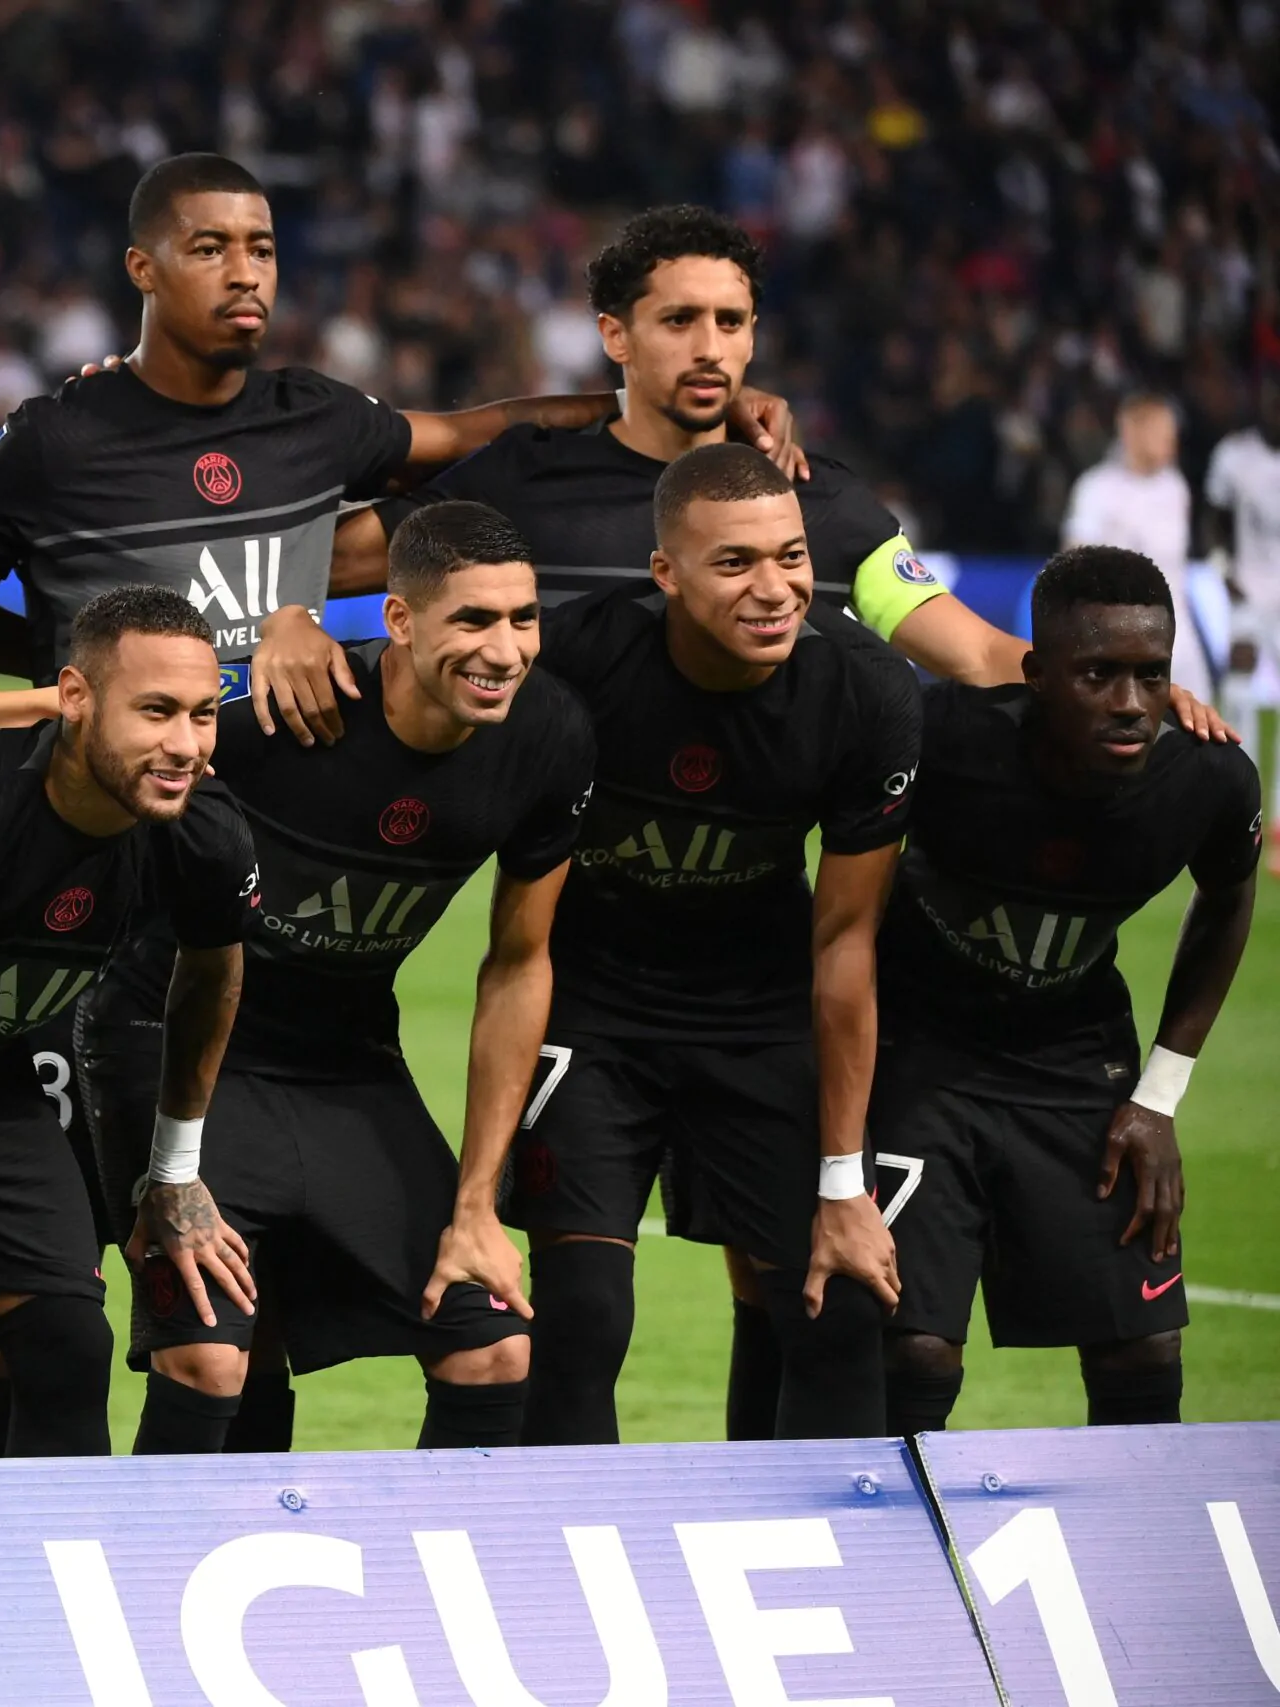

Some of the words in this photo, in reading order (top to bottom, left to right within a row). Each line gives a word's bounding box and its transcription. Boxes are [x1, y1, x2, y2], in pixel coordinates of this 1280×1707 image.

[197, 455, 228, 470] PARIS
[213, 627, 247, 649] IVE
[393, 800, 425, 814] PARIS
[300, 930, 351, 952] LIVE
[976, 952, 1023, 982] LIVE
[32, 1051, 72, 1131] 3
[520, 1044, 573, 1129] 7
[875, 1152, 924, 1229] 7
[967, 1507, 1119, 1707] 1
